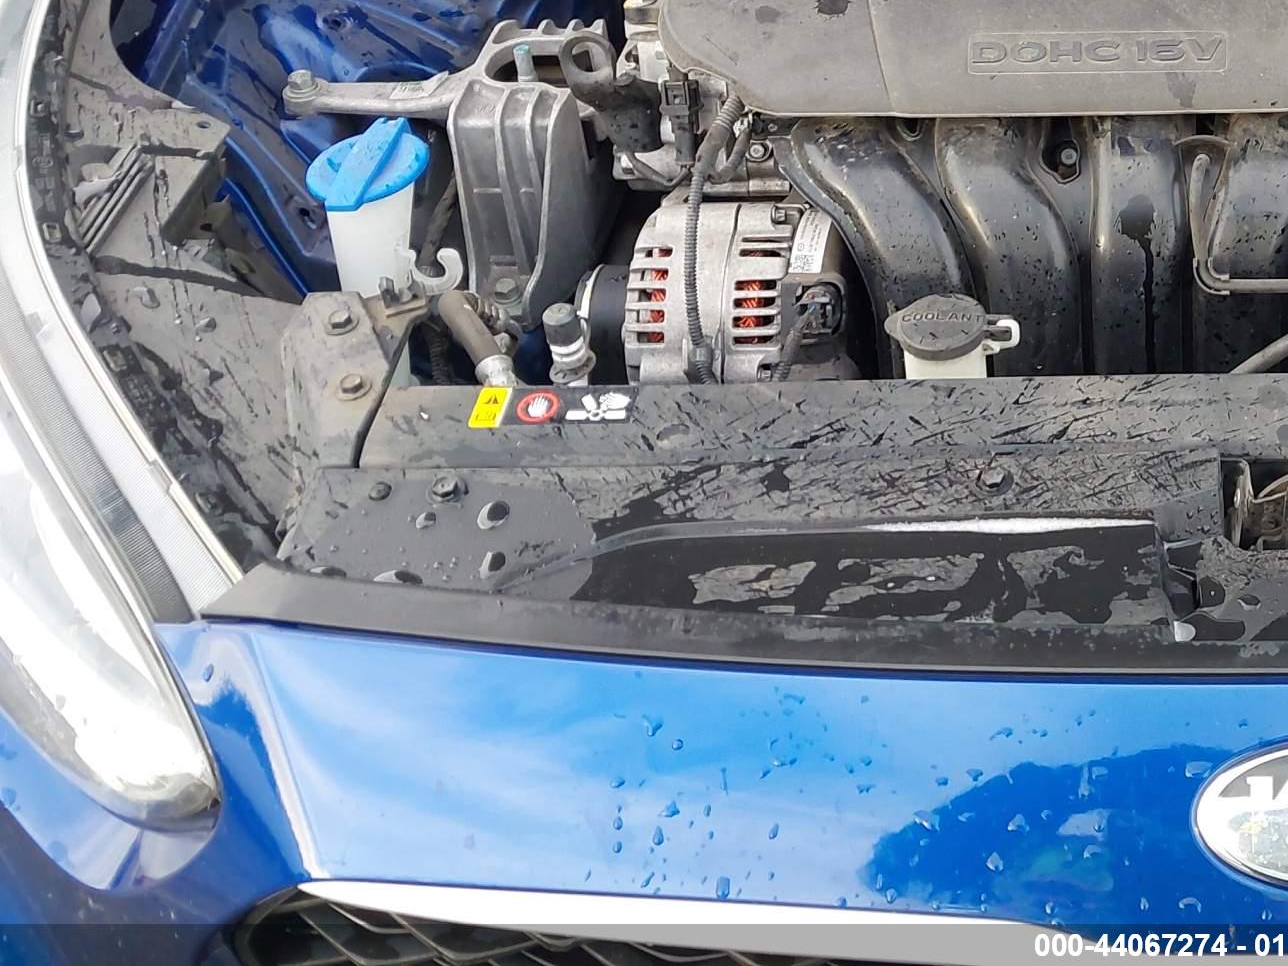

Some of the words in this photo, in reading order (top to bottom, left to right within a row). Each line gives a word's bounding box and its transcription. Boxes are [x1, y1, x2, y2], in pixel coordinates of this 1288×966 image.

[971, 39, 1121, 64] DOHC
[1135, 37, 1223, 63] 16V
[902, 312, 985, 323] COOLANT
